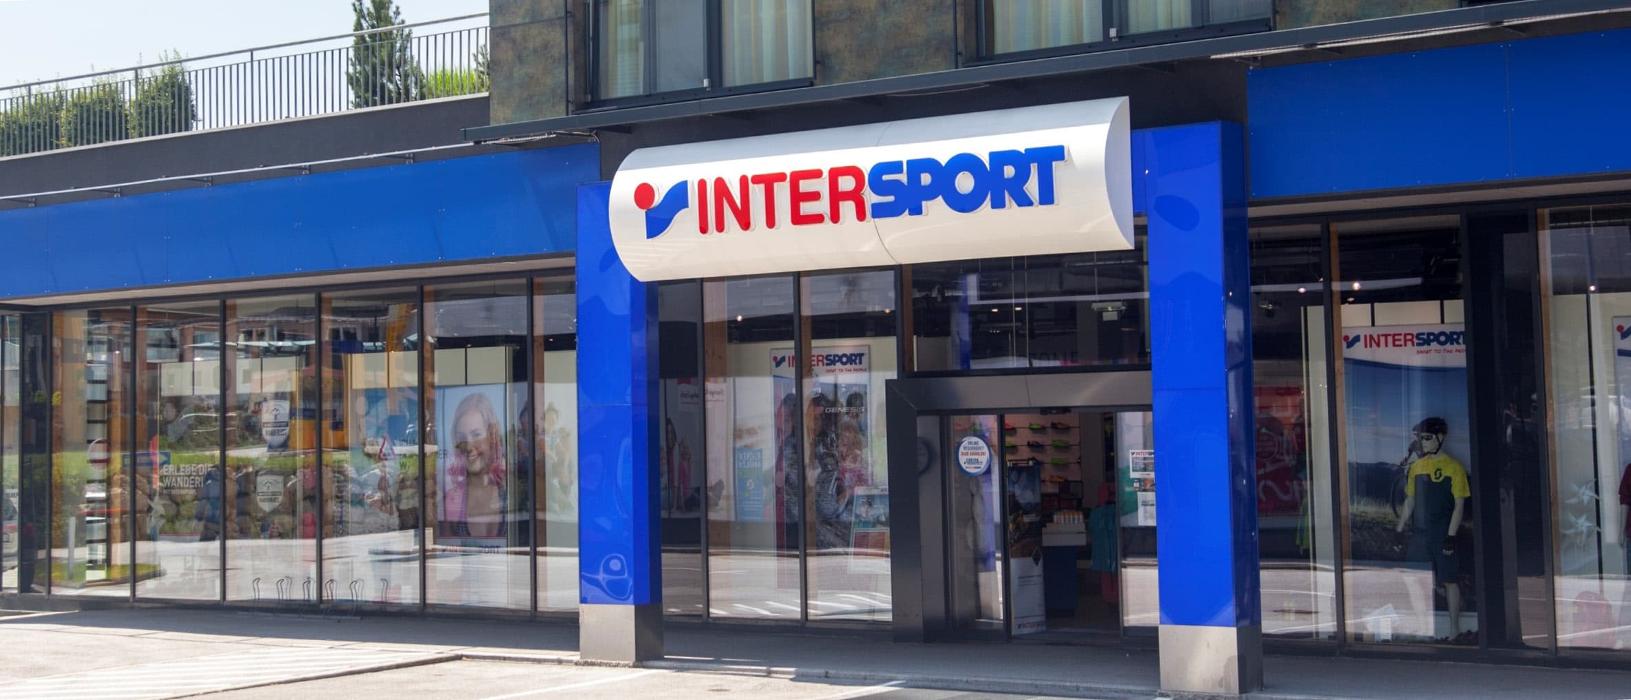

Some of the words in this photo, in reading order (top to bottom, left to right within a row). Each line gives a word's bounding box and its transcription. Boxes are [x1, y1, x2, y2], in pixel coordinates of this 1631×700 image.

[697, 145, 1066, 234] INTERSPORT
[788, 353, 864, 368] IERSPORT
[163, 464, 198, 475] ERLEBE
